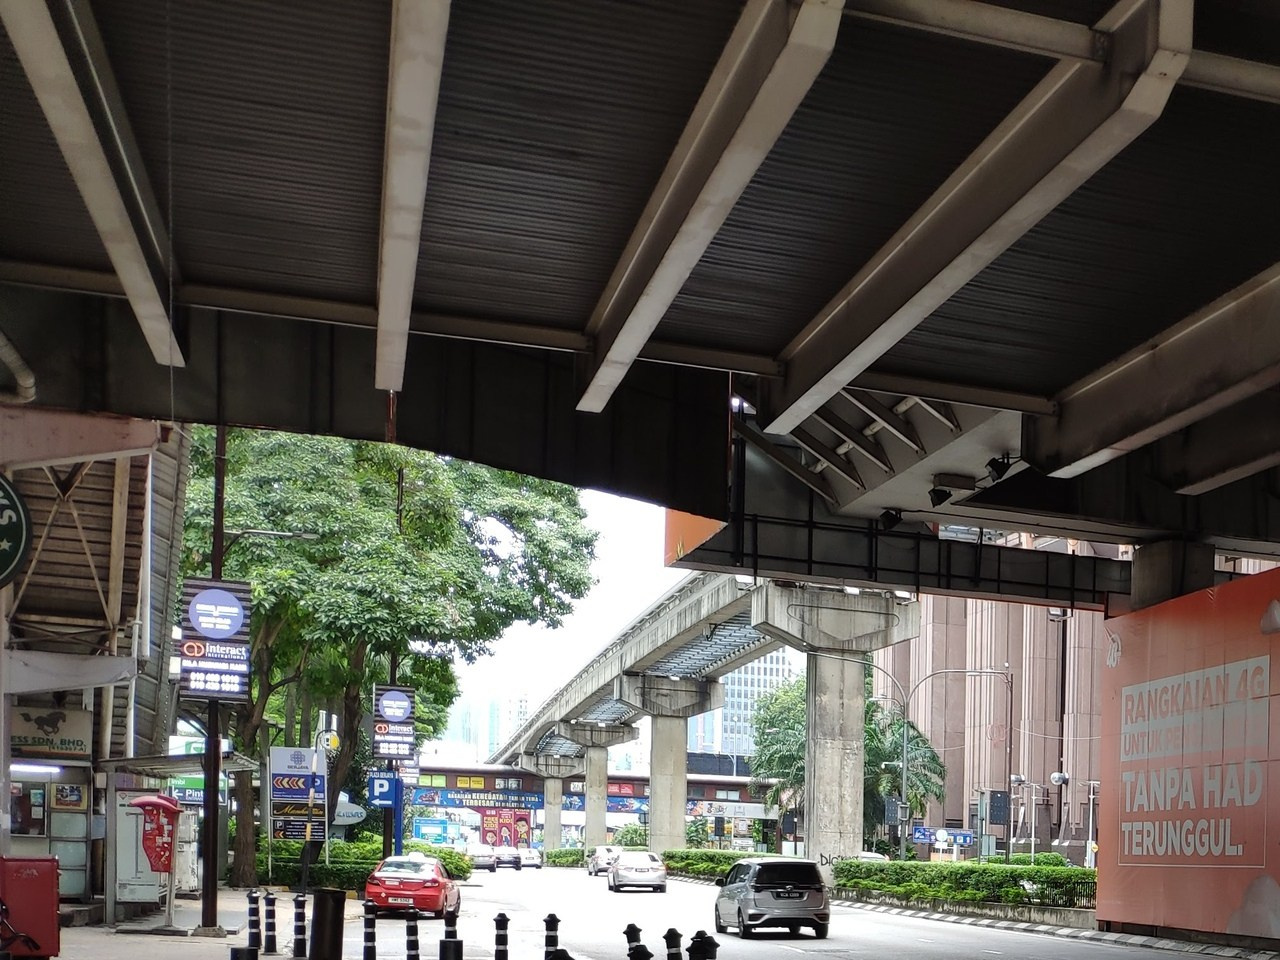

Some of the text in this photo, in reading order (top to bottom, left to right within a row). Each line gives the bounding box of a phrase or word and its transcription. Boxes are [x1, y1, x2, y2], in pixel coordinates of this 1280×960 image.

[1124, 665, 1265, 726] RANGKAIAN 4G
[1123, 729, 1163, 757] UNTUK
[1122, 758, 1264, 813] TANPA HAD
[1122, 818, 1244, 857] TERUNGGUL.
